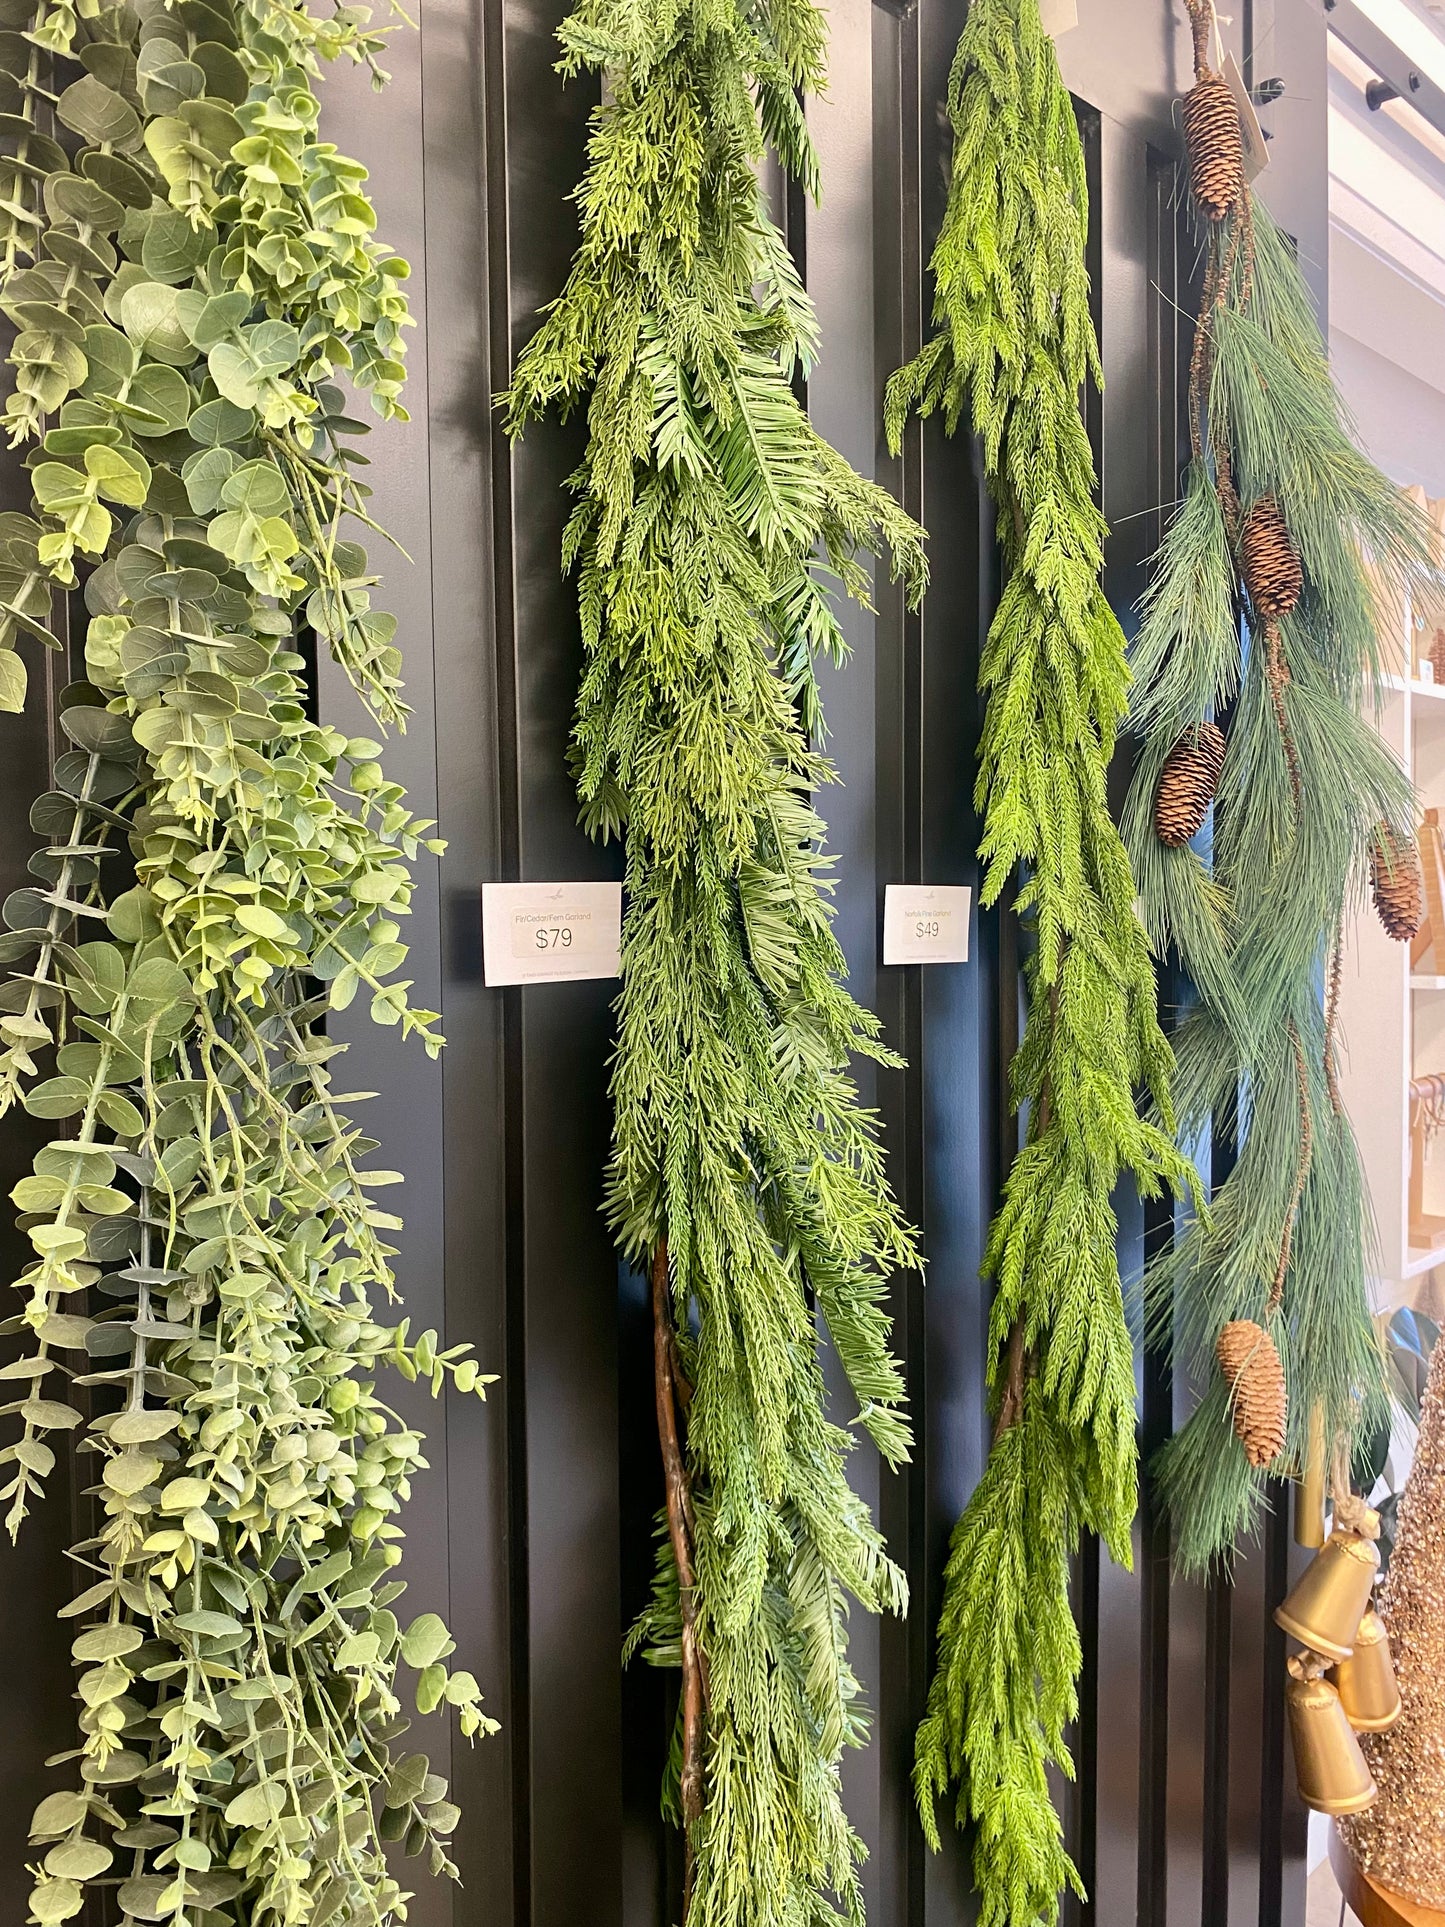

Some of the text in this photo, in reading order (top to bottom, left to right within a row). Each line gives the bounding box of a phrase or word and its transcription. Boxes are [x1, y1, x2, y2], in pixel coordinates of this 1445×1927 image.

[565, 912, 592, 921] Garland
[915, 922, 939, 938] $49
[535, 927, 572, 951] $79
